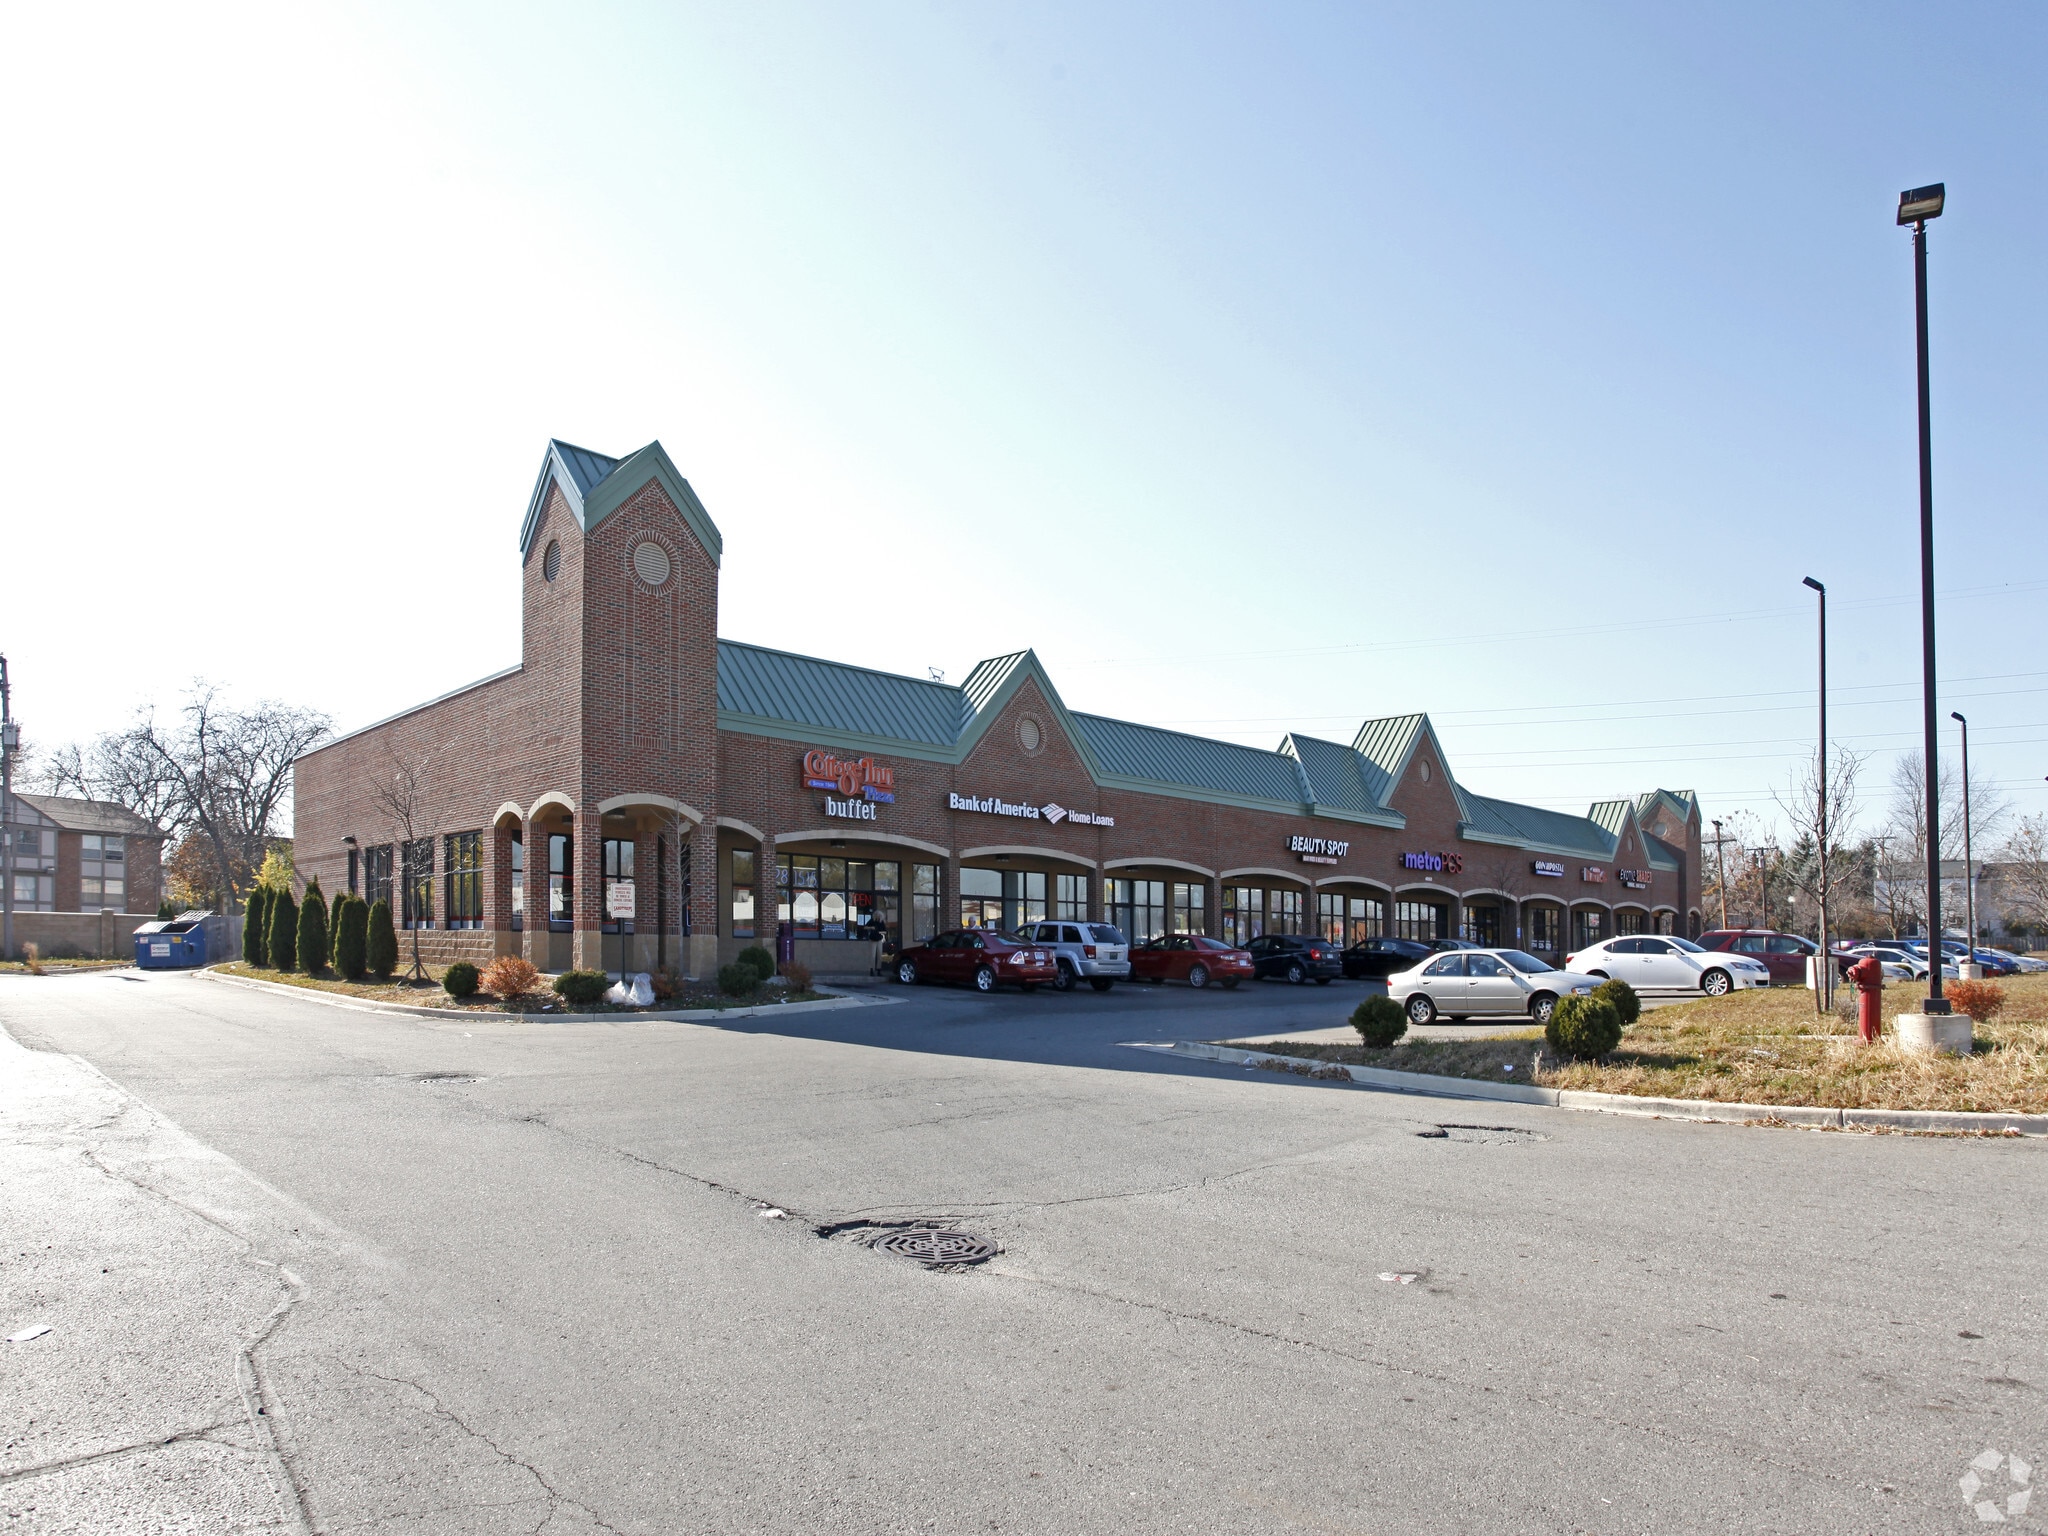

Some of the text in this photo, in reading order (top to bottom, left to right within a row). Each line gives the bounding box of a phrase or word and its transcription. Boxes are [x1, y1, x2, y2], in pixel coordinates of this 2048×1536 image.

[804, 750, 895, 796] Cottage Inn
[863, 786, 895, 804] Pizza
[827, 796, 877, 820] buffet
[950, 793, 1115, 827] Bank of America Home Loans
[1291, 835, 1349, 856] BEAUTY SPOT
[1405, 851, 1463, 874] metroPCS
